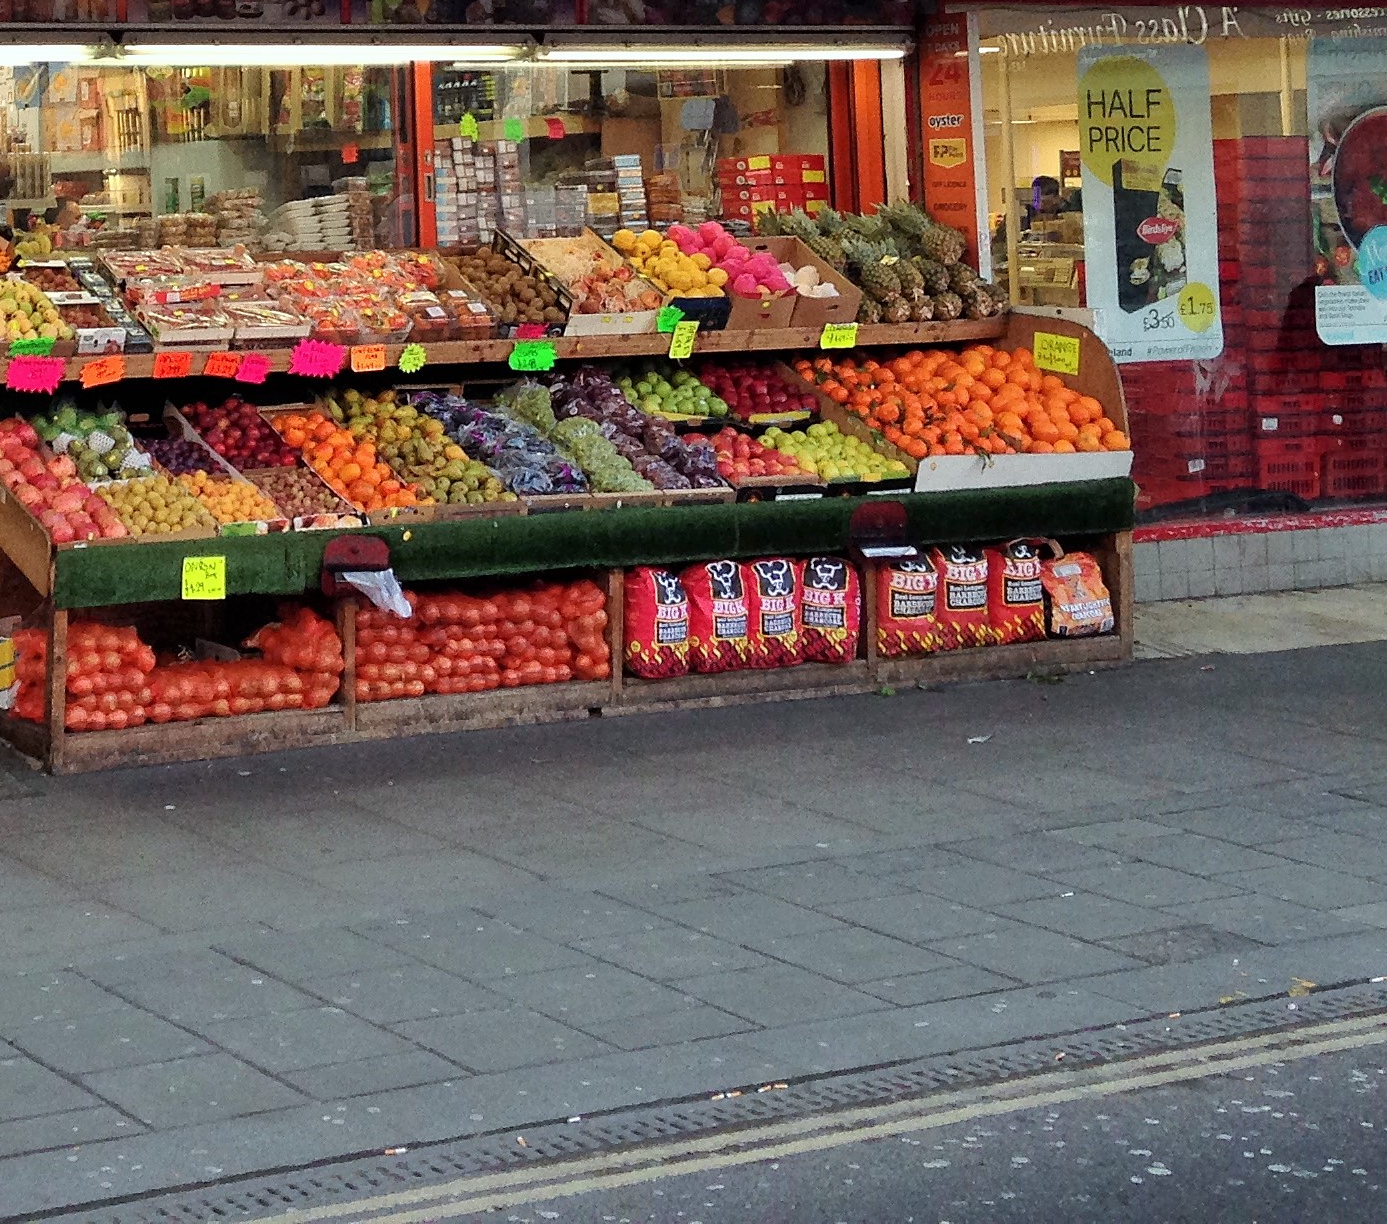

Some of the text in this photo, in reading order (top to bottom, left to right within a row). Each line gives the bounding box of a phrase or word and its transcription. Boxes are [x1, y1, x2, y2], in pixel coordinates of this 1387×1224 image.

[929, 64, 962, 86] 24
[1086, 89, 1162, 119] HALF
[929, 115, 963, 130] oyster
[1089, 126, 1161, 153] PRICE
[890, 573, 925, 591] BIG
[945, 565, 975, 581] BIG
[802, 588, 831, 606] BIG
[657, 605, 679, 619] BIG
